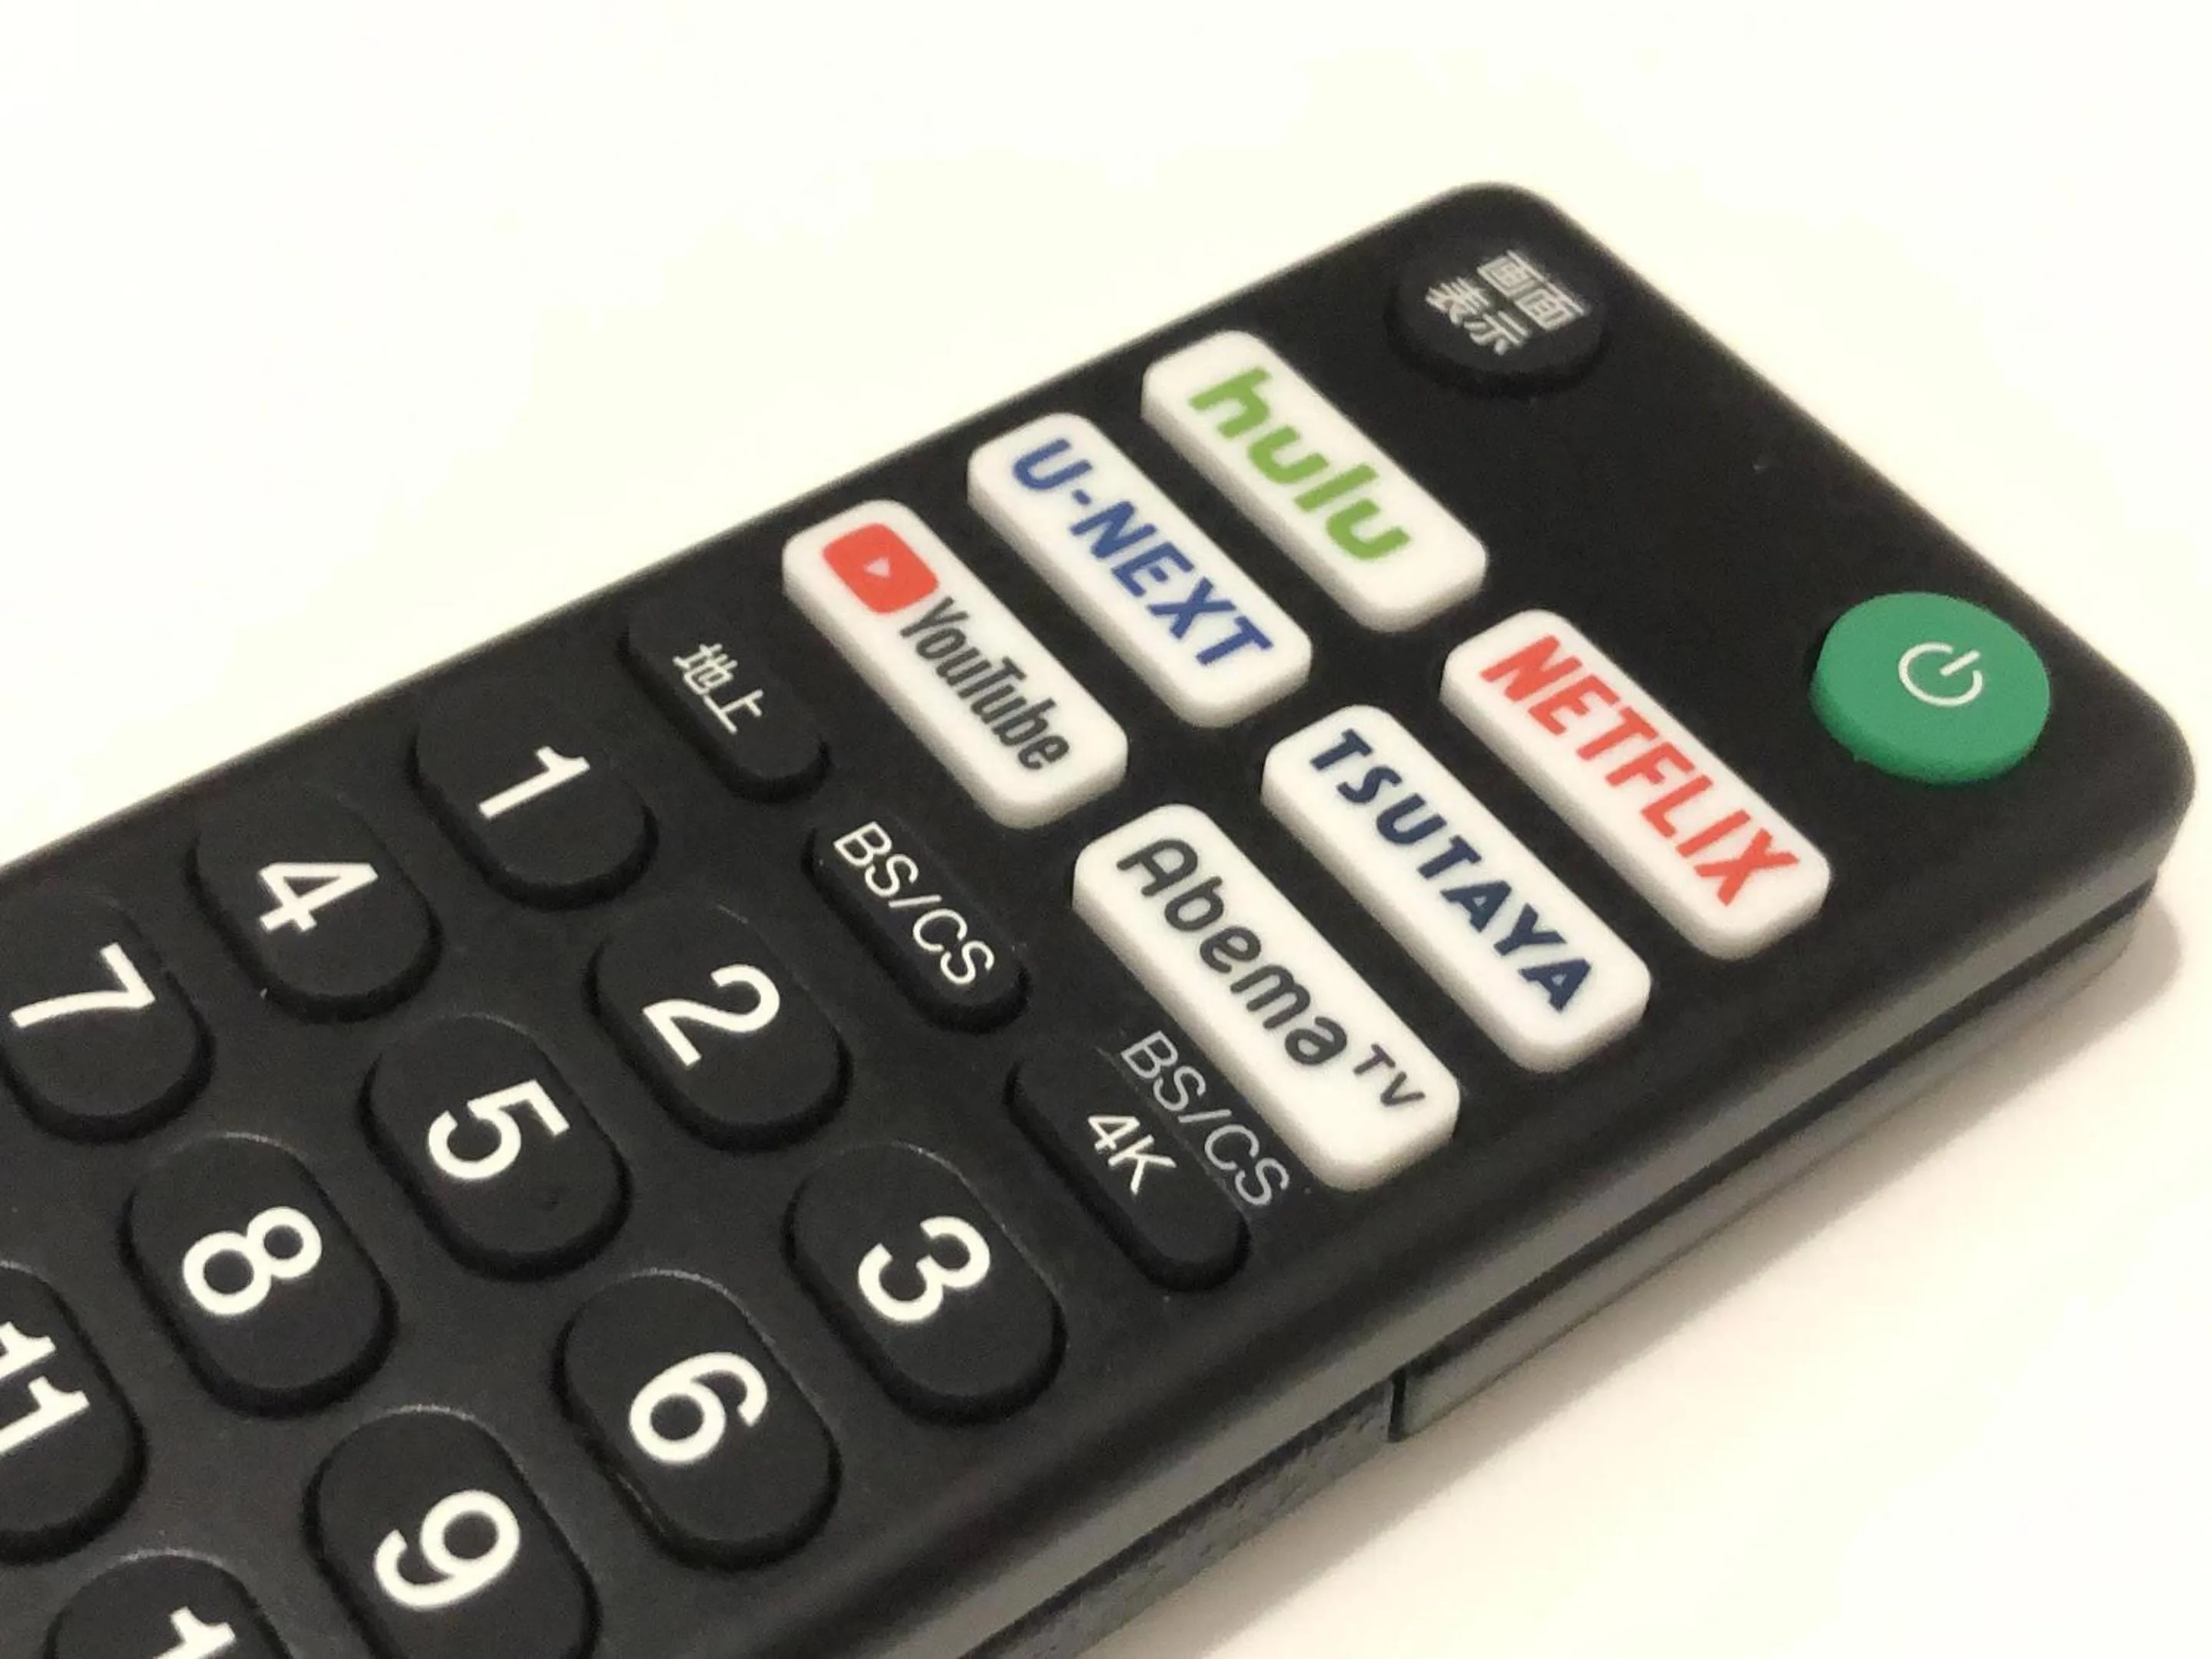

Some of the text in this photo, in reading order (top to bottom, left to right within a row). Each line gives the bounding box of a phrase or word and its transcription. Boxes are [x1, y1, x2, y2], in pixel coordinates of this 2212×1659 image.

[1426, 277, 1530, 355] 表示
[1477, 250, 1585, 331] 画面
[1188, 366, 1411, 561] hulu
[1012, 438, 1273, 665] U-NEXT
[673, 644, 764, 734] 地上
[899, 597, 1070, 770] YouTube
[479, 747, 589, 818] 1
[1480, 635, 1800, 906] NETFLIX
[260, 863, 377, 931] 4
[834, 821, 995, 985] BS/CS
[1310, 729, 1591, 1012] TSUTAYA
[11, 944, 155, 1028] 7
[644, 965, 780, 1066] 2
[1116, 839, 1426, 1108] Abema TV
[429, 1081, 569, 1181] 5
[1088, 1114, 1177, 1195] 4K
[1121, 1030, 1290, 1207] BS/CS
[183, 1207, 322, 1316] 8
[859, 1217, 990, 1323] 3
[629, 1353, 767, 1464] 6
[375, 1491, 519, 1610] 9
